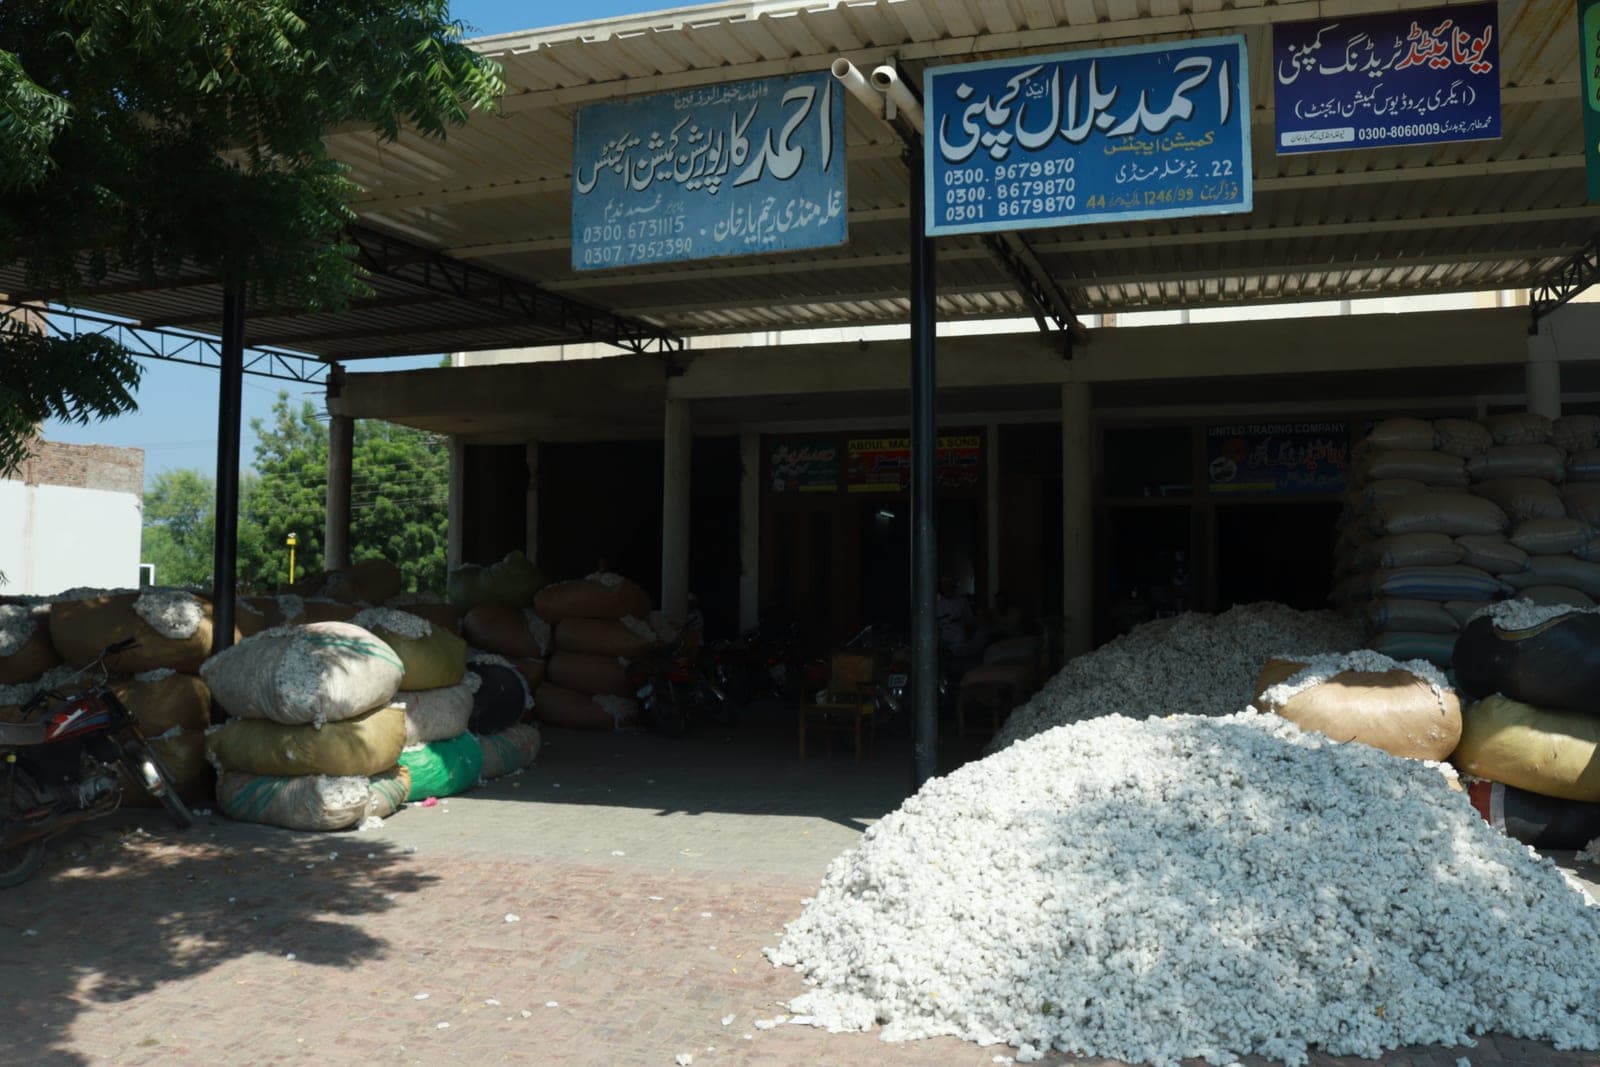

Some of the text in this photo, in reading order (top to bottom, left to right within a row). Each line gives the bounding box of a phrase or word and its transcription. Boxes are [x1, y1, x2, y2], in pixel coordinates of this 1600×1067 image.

[1278, 23, 1340, 85] کمپنی
[1319, 32, 1402, 78] ٹریڈنگ
[939, 64, 1045, 162] کمپنی
[1015, 60, 1118, 149] بلال
[1106, 56, 1231, 138] احمد
[1342, 83, 1384, 117] کمیشن
[733, 79, 834, 189] احمد
[1162, 131, 1216, 152] کمیشن
[1358, 122, 1440, 141] 0300-8060009
[630, 115, 690, 191] کمیشن
[994, 157, 1075, 181] 9679870
[1158, 159, 1187, 181] غلہ
[997, 178, 1076, 198] 8679870
[1114, 162, 1159, 184] منڈی
[777, 197, 822, 233] منڈی
[818, 188, 842, 226] غلہ
[946, 196, 1076, 221] 0301 8679870
[1209, 423, 1346, 436] UNITED TRADING COMPANY
